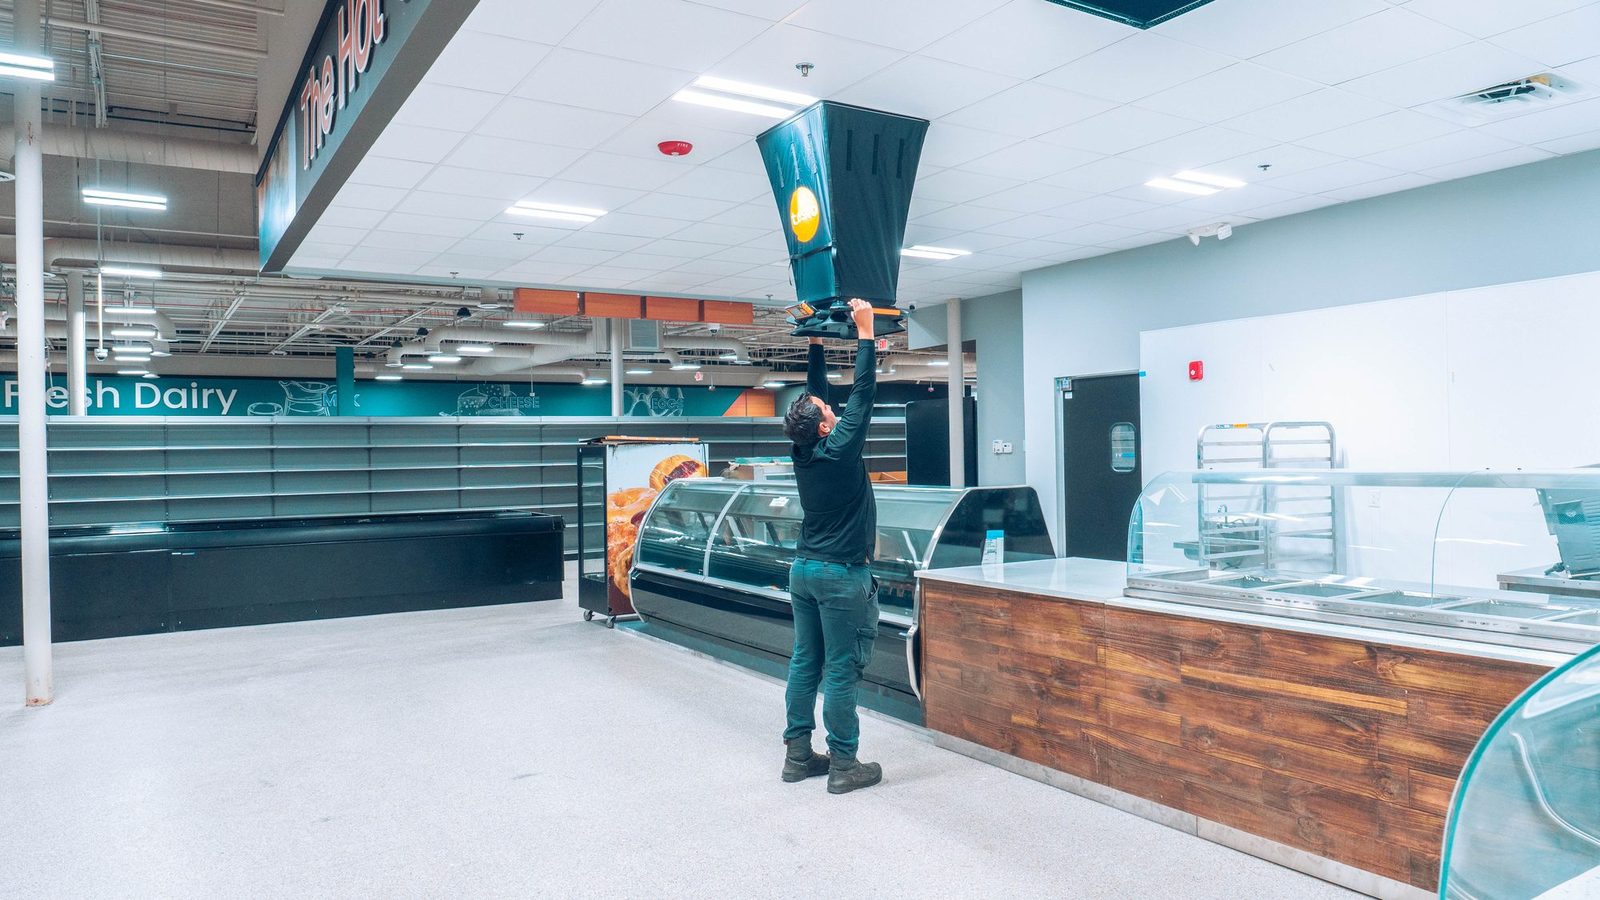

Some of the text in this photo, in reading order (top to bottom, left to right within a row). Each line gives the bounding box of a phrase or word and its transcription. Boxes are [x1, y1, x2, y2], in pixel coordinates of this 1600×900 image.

[301, 55, 334, 170] The
[4, 380, 237, 415] Feh Dairy
[487, 396, 540, 409] CHEESE
